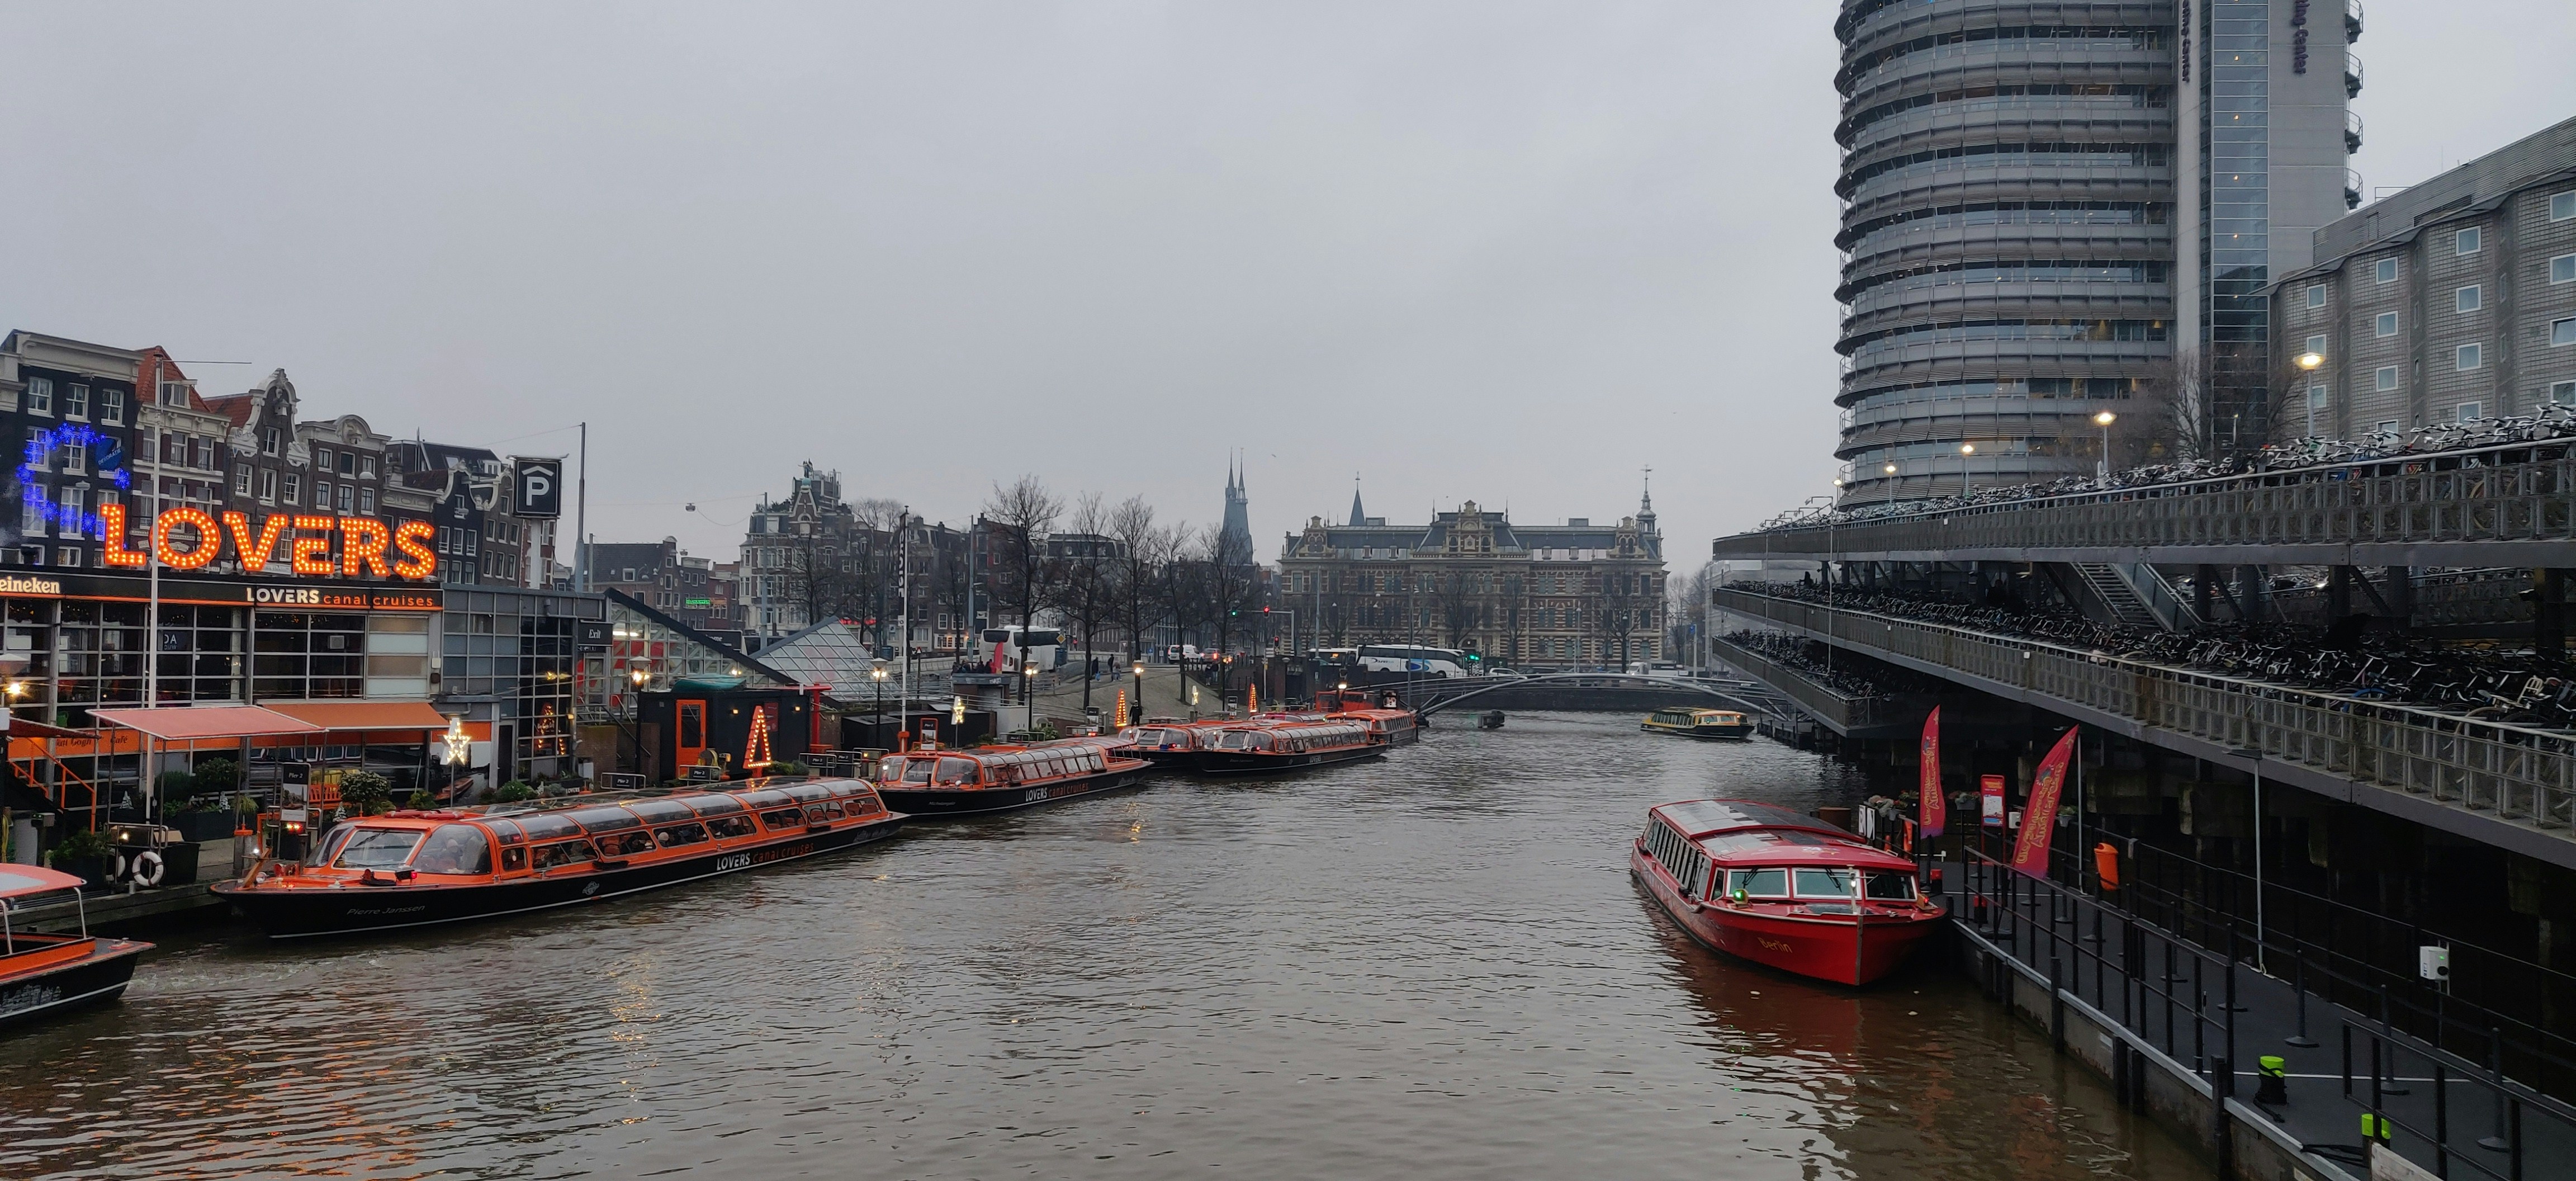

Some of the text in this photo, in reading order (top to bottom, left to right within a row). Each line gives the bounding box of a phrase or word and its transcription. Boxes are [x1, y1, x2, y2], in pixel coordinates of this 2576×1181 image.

[2294, 29, 2309, 74] Center
[527, 476, 550, 506] P
[100, 504, 435, 579] LOVERS
[246, 587, 434, 607] LOVERS canal cruises
[588, 629, 601, 639] Exit
[1026, 783, 1088, 801] LOVERS canal cruises
[717, 842, 815, 871] LOVERS canal cruises
[382, 905, 425, 914] Janssen
[1758, 937, 1792, 953] Berlin
